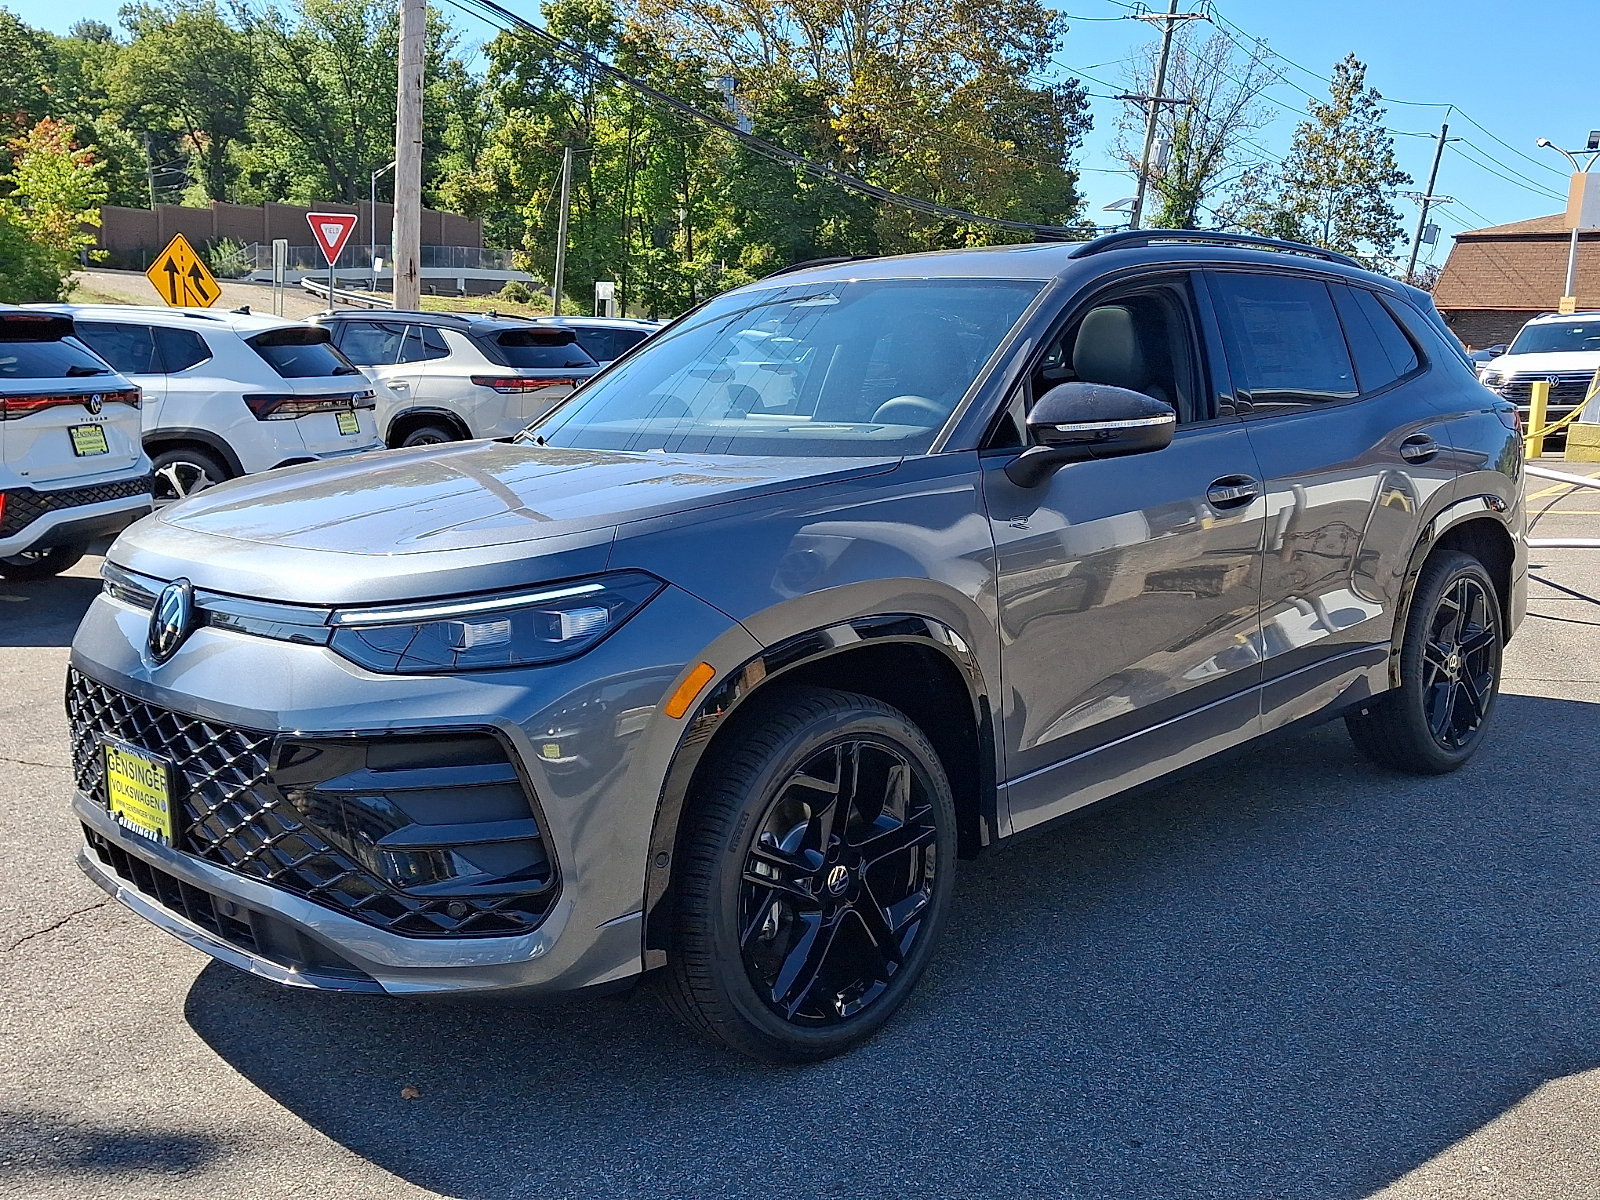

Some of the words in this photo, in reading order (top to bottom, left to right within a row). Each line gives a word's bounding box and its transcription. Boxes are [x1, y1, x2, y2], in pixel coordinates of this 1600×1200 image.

[107, 753, 167, 793] GENSINGER
[111, 779, 160, 809] VOLKSWAGEN
[118, 816, 158, 842] GENSINGER
